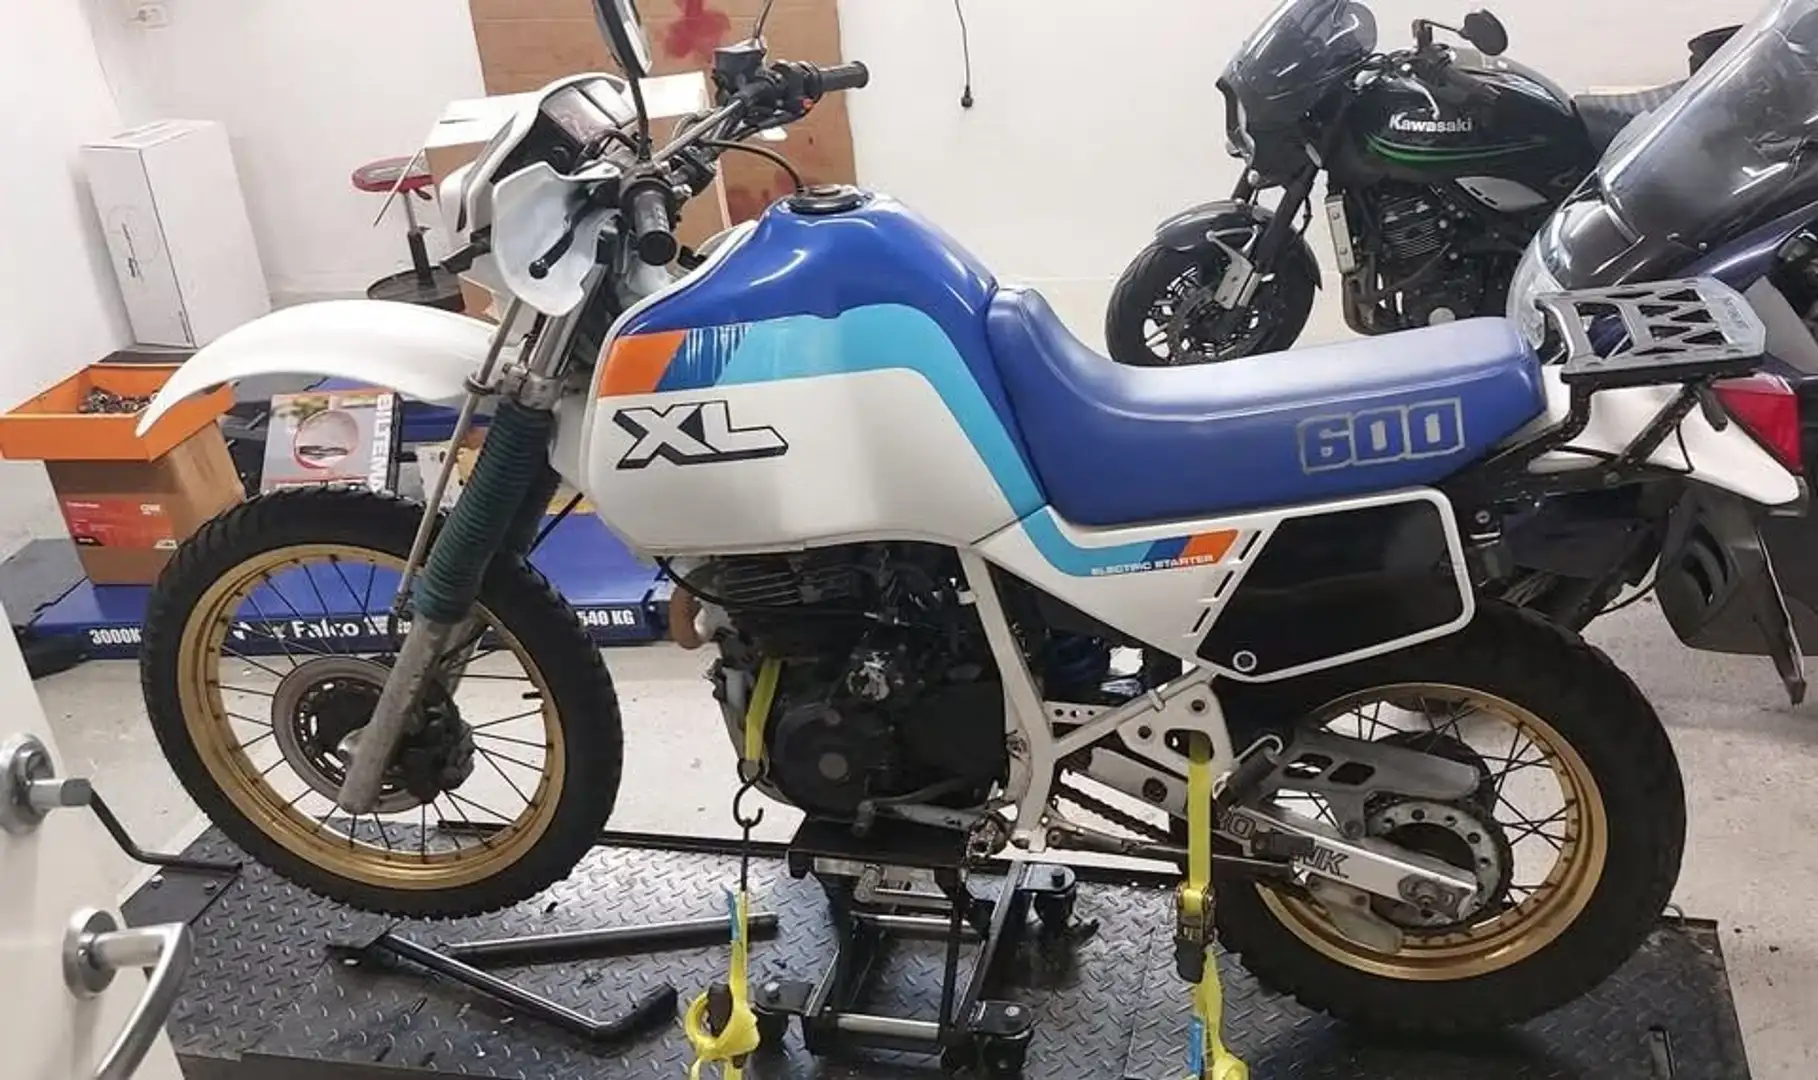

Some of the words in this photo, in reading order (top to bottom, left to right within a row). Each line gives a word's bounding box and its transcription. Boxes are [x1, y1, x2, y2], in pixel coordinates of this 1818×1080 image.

[1389, 112, 1472, 132] Kawasaki
[612, 400, 789, 470] XL
[1297, 396, 1465, 475] 600
[1091, 561, 1152, 576] ELECTRIC
[1155, 554, 1214, 569] STARTER
[611, 609, 636, 625] KG
[89, 628, 142, 645] 3000K
